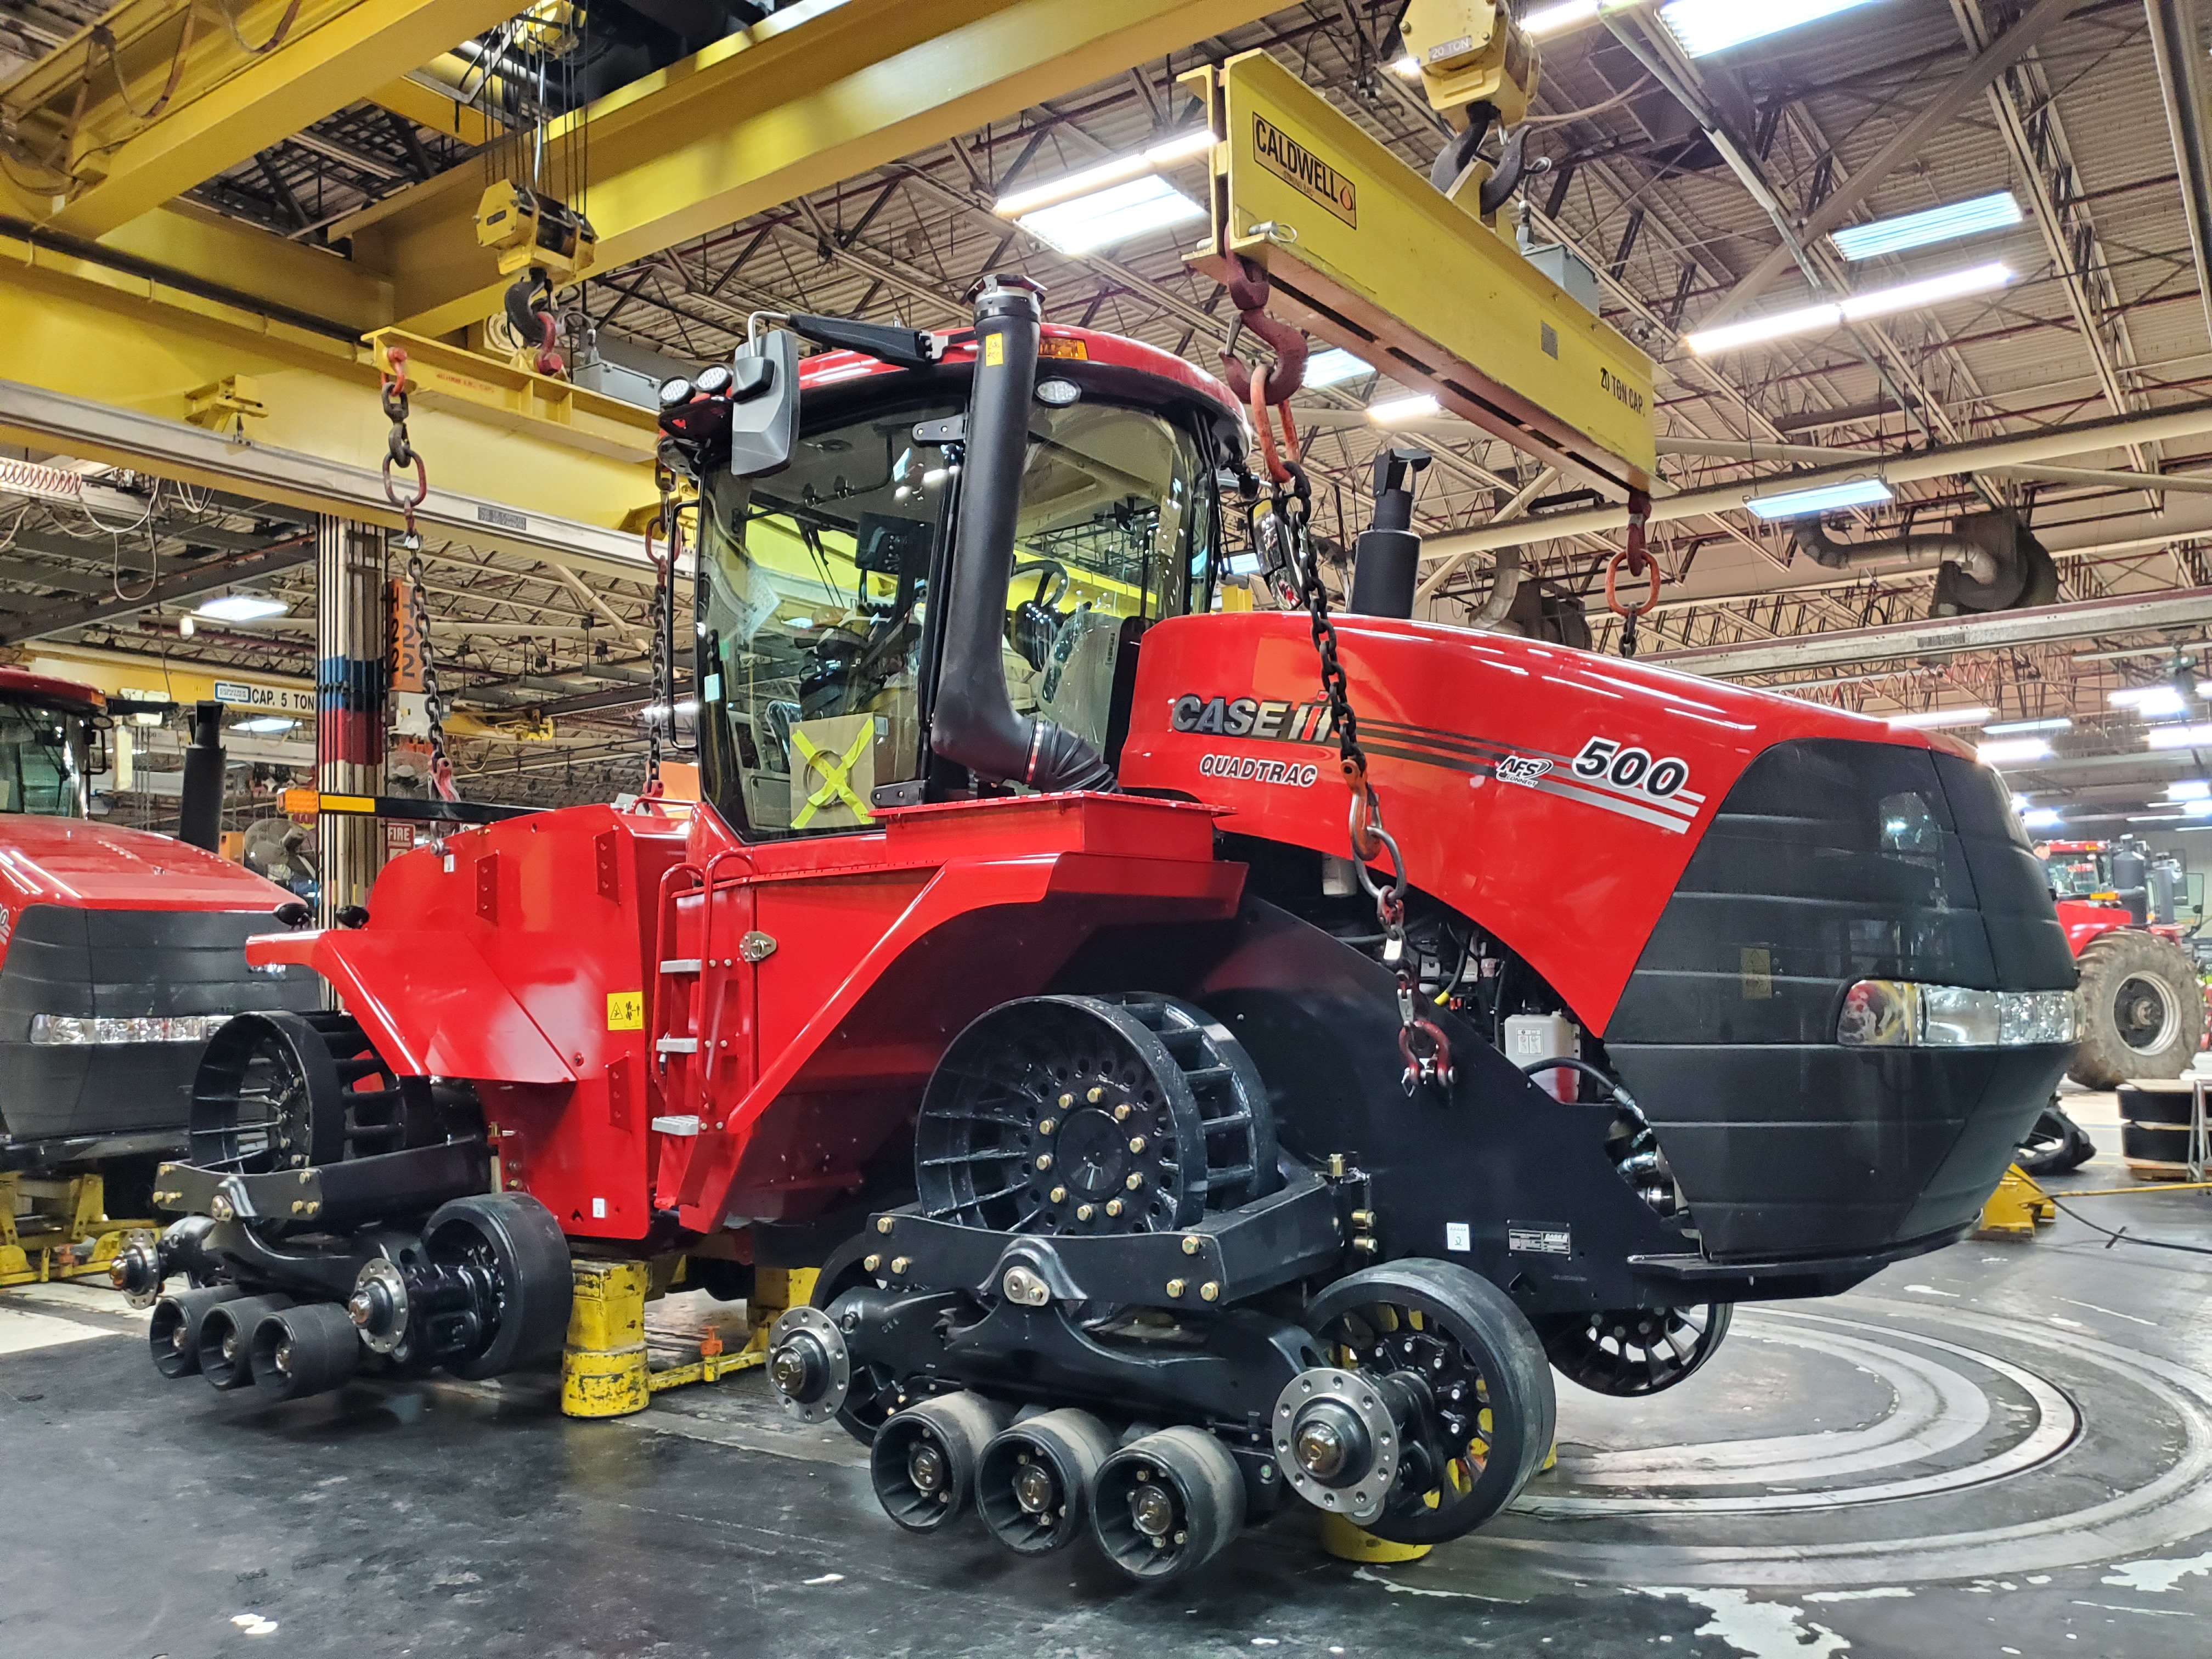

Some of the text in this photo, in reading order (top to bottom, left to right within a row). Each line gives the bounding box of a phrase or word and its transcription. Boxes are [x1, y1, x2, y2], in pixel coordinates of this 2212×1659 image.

[1432, 37, 1469, 58] 20 TON
[1256, 119, 1338, 204] CALDWELL
[1600, 367, 1610, 392] 20
[1612, 375, 1627, 405] TON
[252, 689, 275, 706] CAP.
[281, 692, 287, 707] 5
[294, 694, 314, 710] TON
[1172, 693, 1291, 737] CASE
[1200, 754, 1317, 787] QUADTRAC
[1499, 758, 1539, 776] AFS
[1506, 774, 1538, 787] CONNECT
[1573, 737, 1688, 798] 500
[388, 826, 410, 842] FIRE
